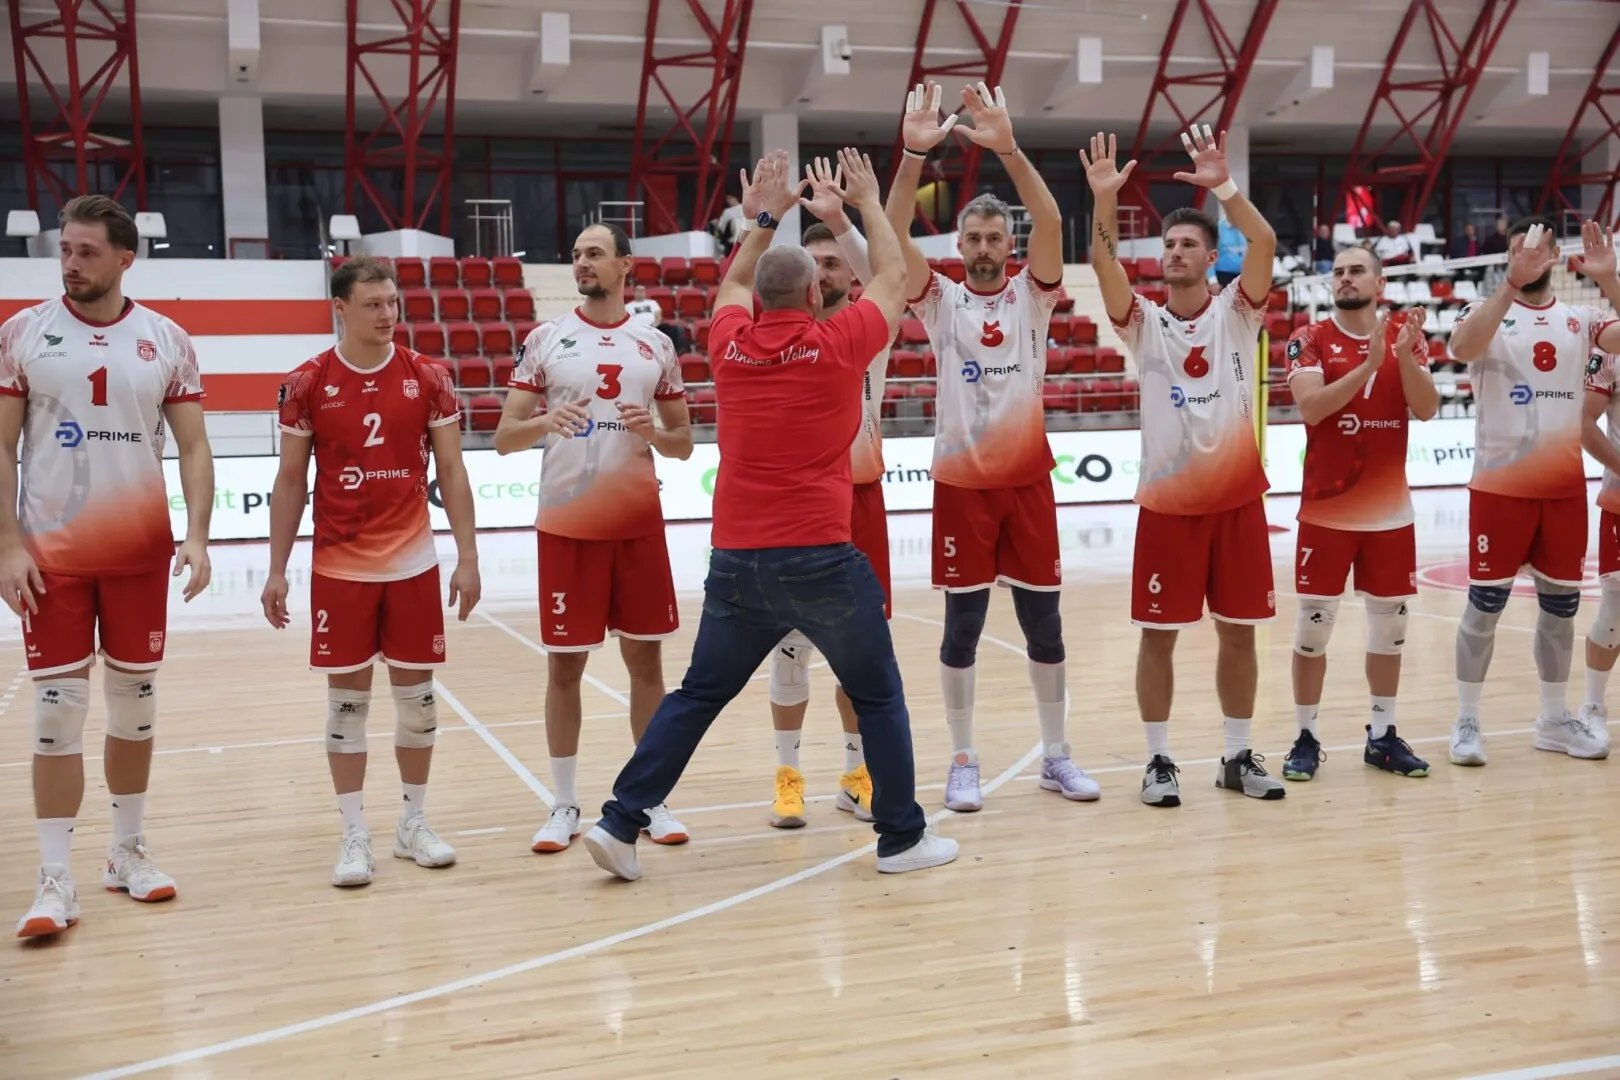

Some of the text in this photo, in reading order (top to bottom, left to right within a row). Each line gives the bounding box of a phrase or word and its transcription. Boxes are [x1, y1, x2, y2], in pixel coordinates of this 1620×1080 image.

[980, 320, 1004, 347] 5
[780, 345, 819, 365] Volley
[1183, 346, 1209, 379] 6
[1533, 341, 1557, 372] 8
[984, 363, 1021, 376] PRIME
[87, 365, 108, 406] 1
[595, 364, 624, 400] 3
[864, 370, 872, 401] DRINKS
[1535, 390, 1575, 400] PRIME
[363, 412, 385, 448] 2
[1363, 419, 1401, 429] PRIME
[87, 430, 142, 443] PRIME
[366, 468, 410, 481] PRIME
[944, 536, 957, 558] 5
[1477, 534, 1489, 554] 8
[1301, 547, 1314, 567] 7
[1148, 573, 1162, 594] 6
[552, 592, 567, 615] 3
[317, 609, 329, 633] 2
